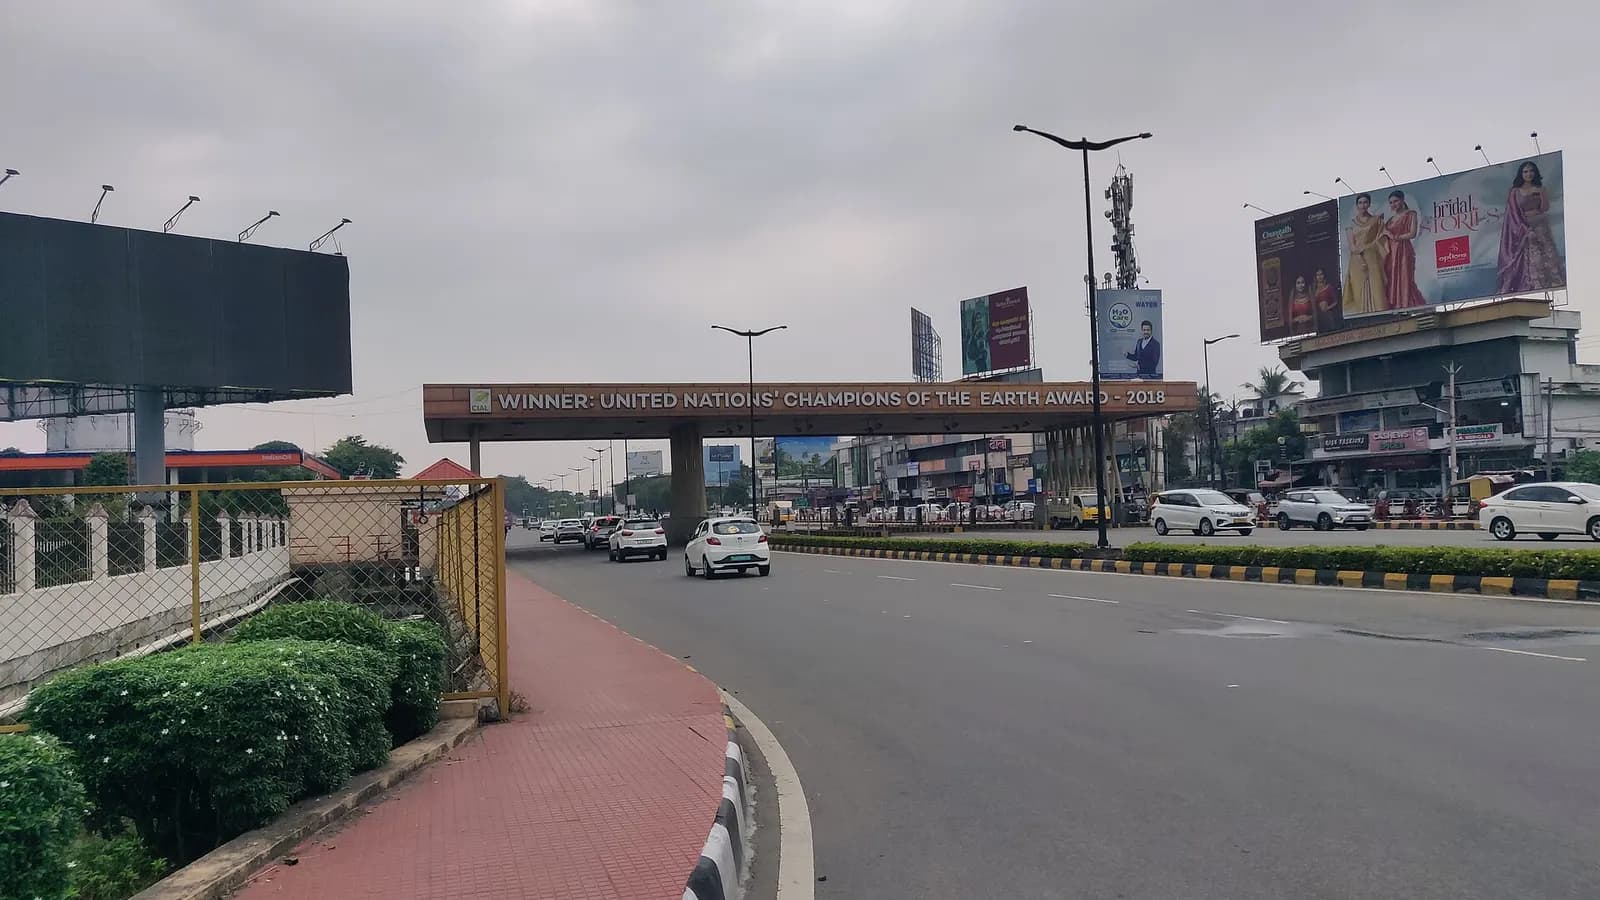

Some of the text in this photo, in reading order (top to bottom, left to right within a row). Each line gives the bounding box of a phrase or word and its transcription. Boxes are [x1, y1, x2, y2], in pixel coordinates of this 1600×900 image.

[1433, 194, 1473, 218] bridal
[1135, 301, 1158, 309] WATER
[498, 393, 595, 410] WINNER:
[599, 392, 678, 409] UNITED
[683, 391, 779, 408] NATIONS'
[783, 391, 901, 408] CHAMPIONS
[906, 391, 931, 407] OF
[935, 391, 971, 406] THE
[980, 390, 1040, 406] EARTH
[1045, 390, 1109, 405] AWARD
[1126, 390, 1166, 405] 2018
[472, 404, 489, 412] CIAL
